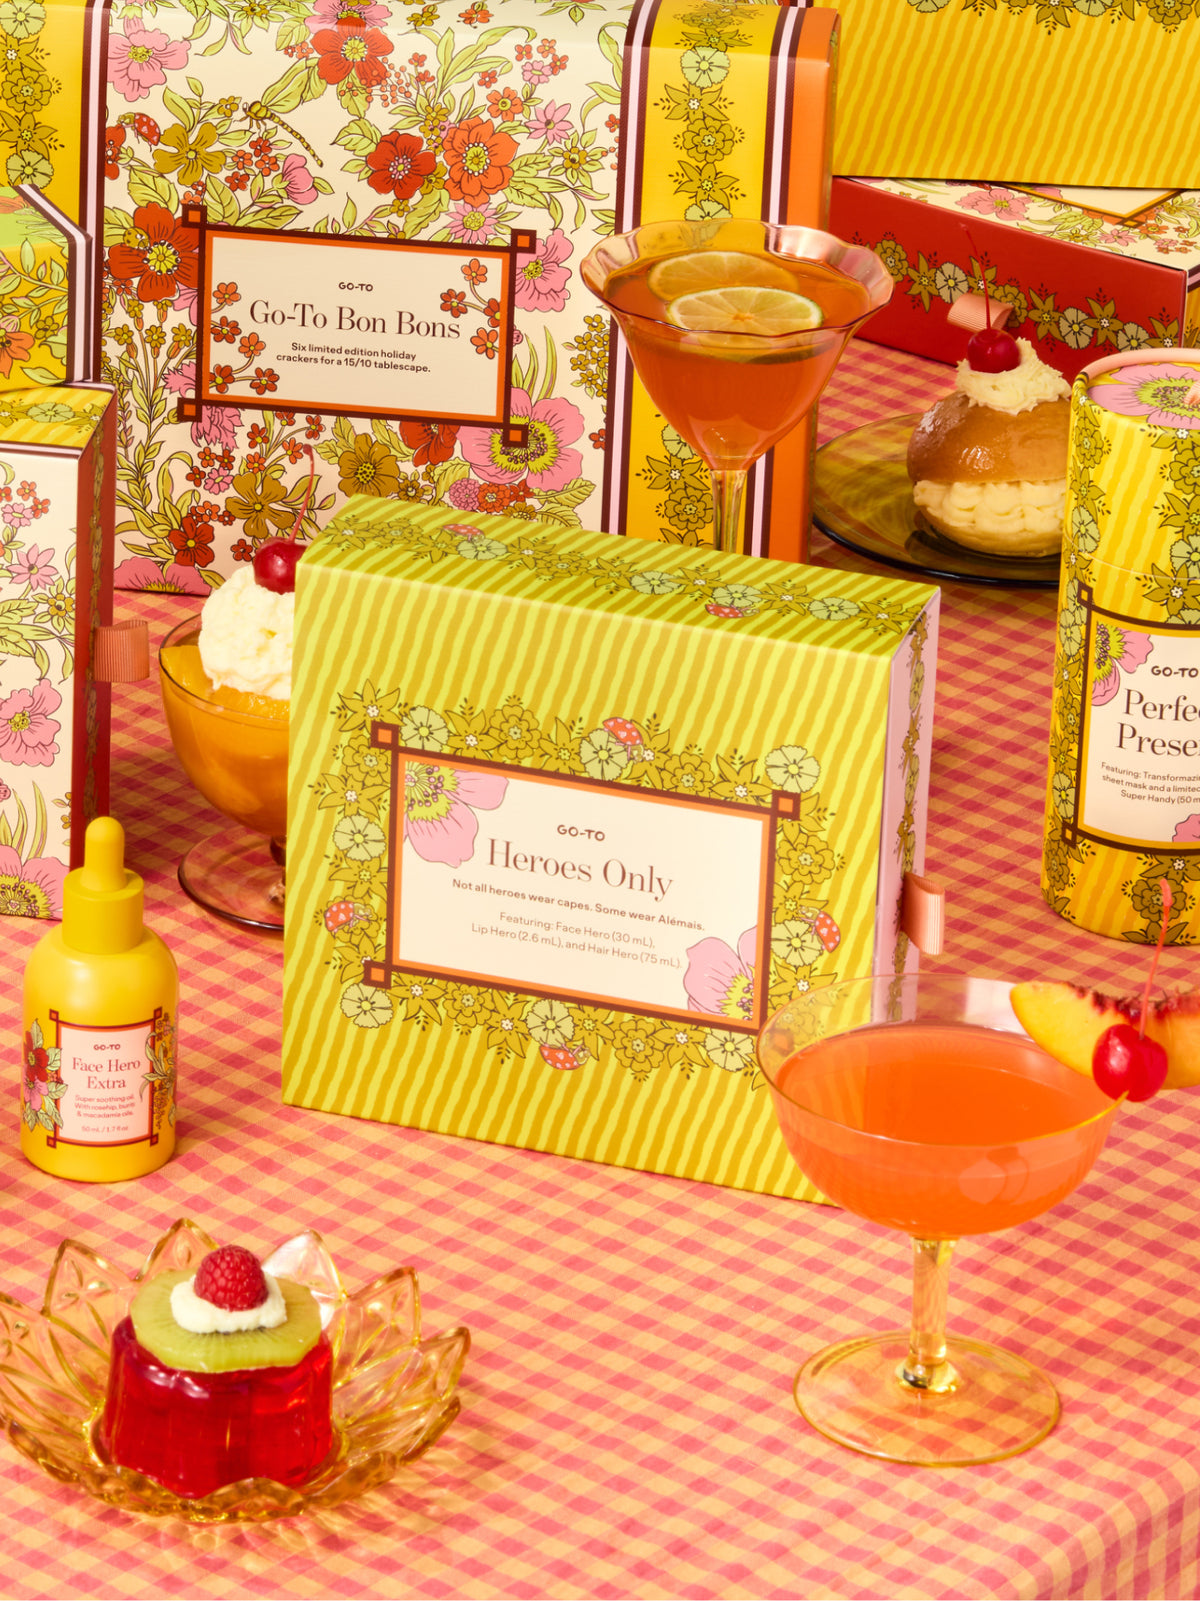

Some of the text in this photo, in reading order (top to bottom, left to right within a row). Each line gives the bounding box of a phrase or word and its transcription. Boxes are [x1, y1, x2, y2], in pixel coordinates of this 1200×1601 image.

[338, 281, 374, 292] GO-TO
[250, 299, 461, 339] Go-To Bon Bons
[291, 342, 417, 362] Six limited edition holiday
[276, 354, 319, 364] crackers
[320, 356, 335, 365] for
[343, 358, 372, 368] 15/10
[374, 361, 431, 374] tablescape.
[1151, 665, 1199, 678] GO-TO
[1122, 688, 1200, 722] Perfe
[1115, 722, 1200, 757] Prese
[1101, 761, 1141, 779] Featuring:
[1102, 774, 1124, 786] sheet
[1125, 780, 1147, 791] mask
[1148, 782, 1165, 792] and
[1166, 785, 1172, 793] a
[1120, 789, 1146, 801] Super
[1147, 794, 1176, 805] Handy
[1177, 795, 1192, 804] (50
[556, 824, 606, 842] GO-TO
[487, 837, 674, 902] Heroes Only
[452, 878, 705, 931] Not all heroes wear capes. Some wear Alémais.
[500, 912, 656, 949] Featuring: Face Hero (30 mL),
[471, 923, 488, 936] Lip
[490, 926, 517, 939] Hero
[518, 930, 539, 943] (2.6
[541, 936, 564, 949] mL),
[565, 941, 586, 952] and
[587, 943, 610, 955] Hair
[612, 947, 639, 961] Hero
[639, 951, 658, 964] (75
[93, 1043, 121, 1051] GO-TO
[72, 1057, 141, 1073] Face Hero
[87, 1075, 127, 1090] Extra
